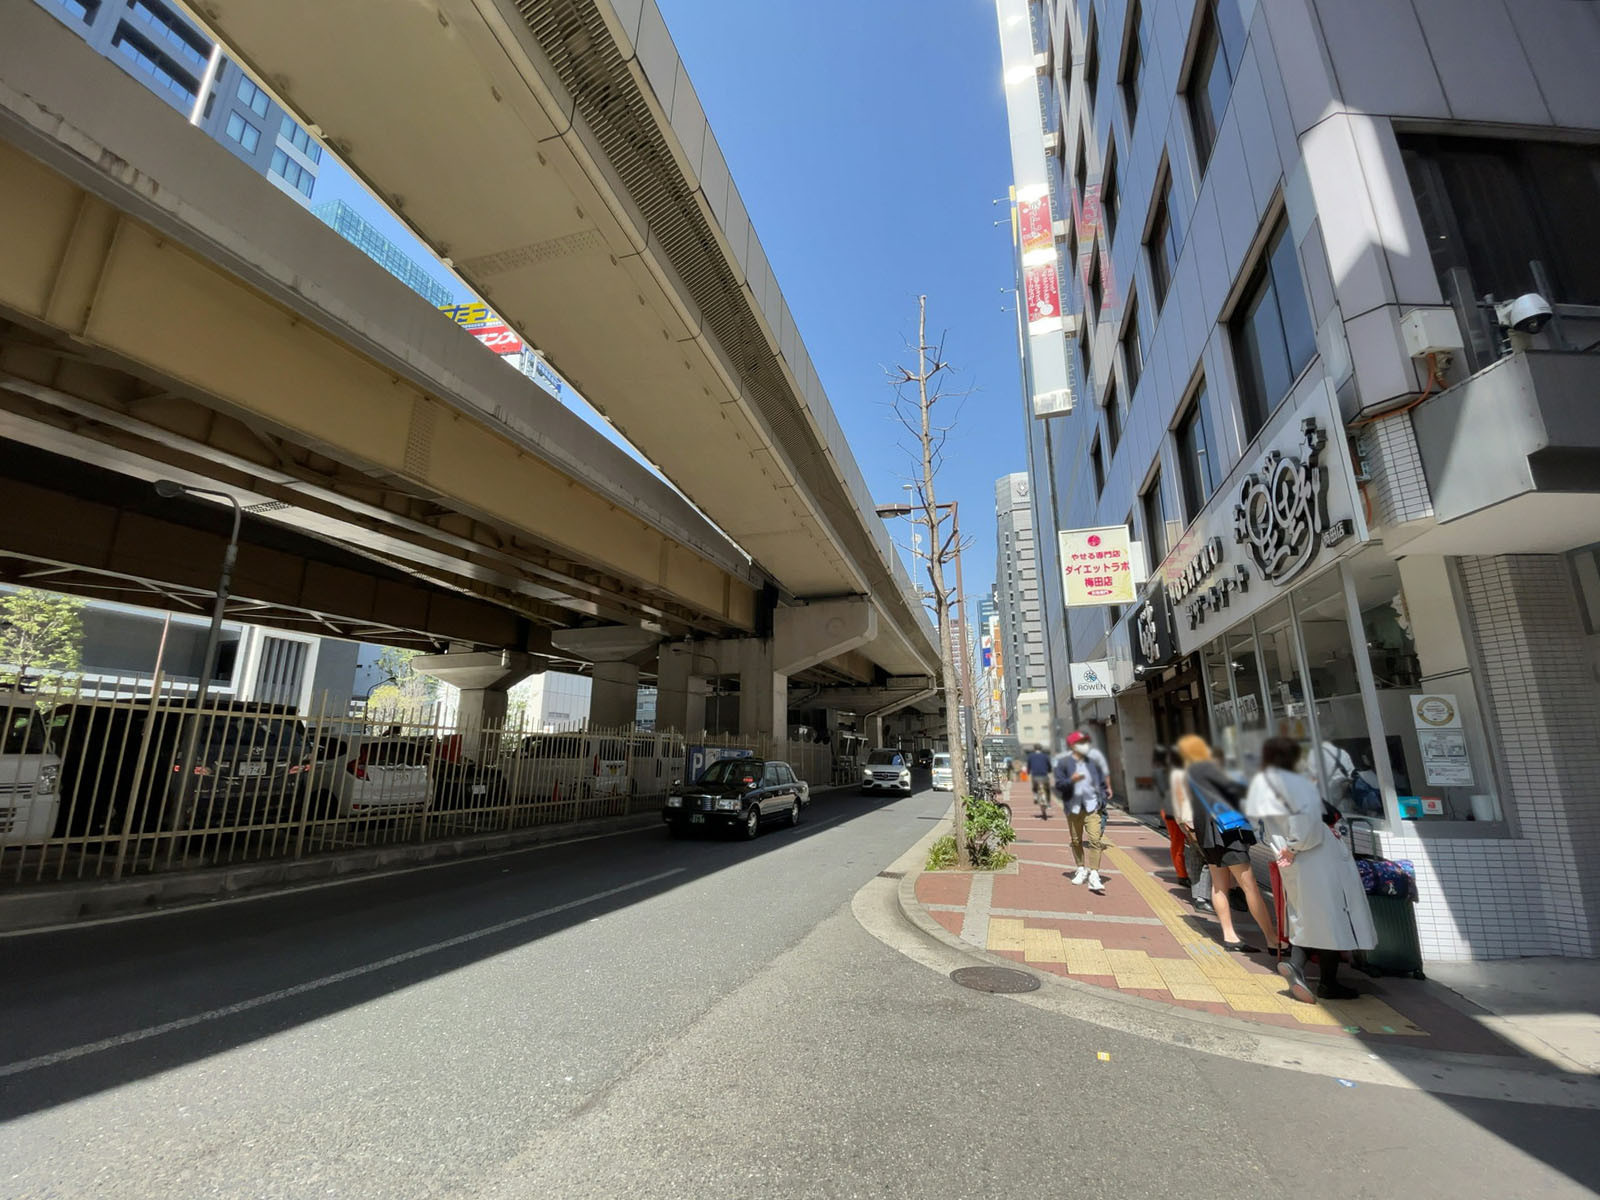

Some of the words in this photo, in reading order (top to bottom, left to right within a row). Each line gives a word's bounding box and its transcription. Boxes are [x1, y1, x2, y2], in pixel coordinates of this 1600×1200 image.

[1071, 550, 1121, 561] やせる専門店
[1084, 576, 1113, 588] 梅田店
[692, 752, 703, 781] P
